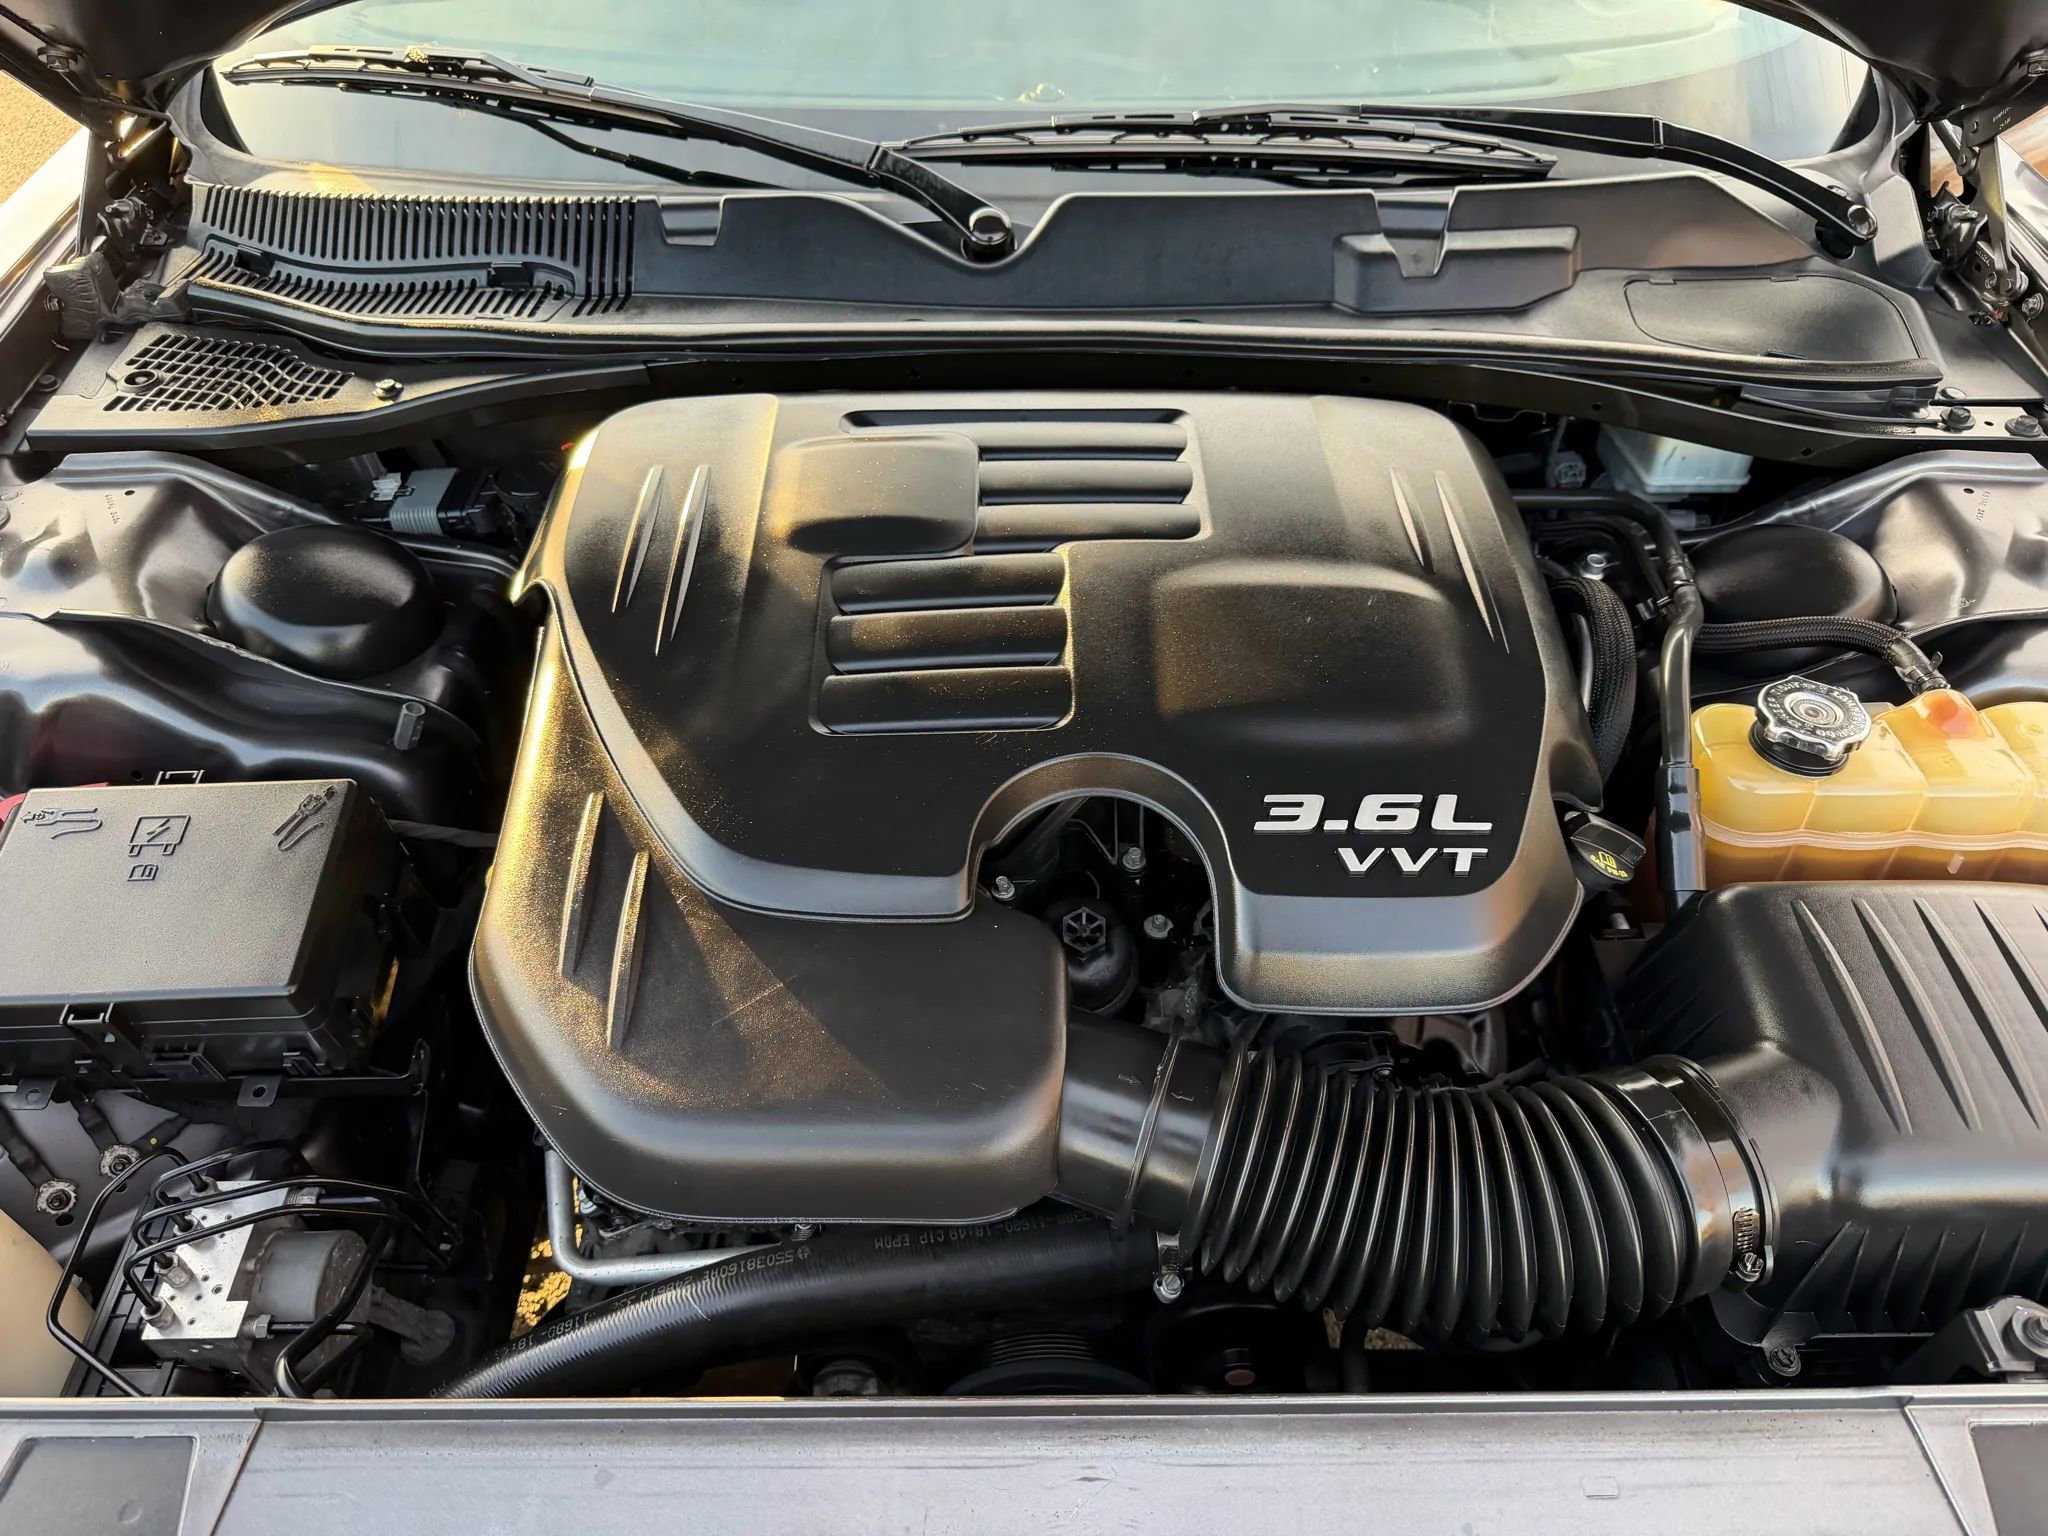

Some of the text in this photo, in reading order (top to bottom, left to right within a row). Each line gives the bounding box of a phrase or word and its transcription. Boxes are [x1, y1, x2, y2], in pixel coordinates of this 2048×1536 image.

[1253, 793, 1493, 834] 3.6L
[1337, 847, 1489, 876] VVT
[874, 1234, 910, 1250] EPDM
